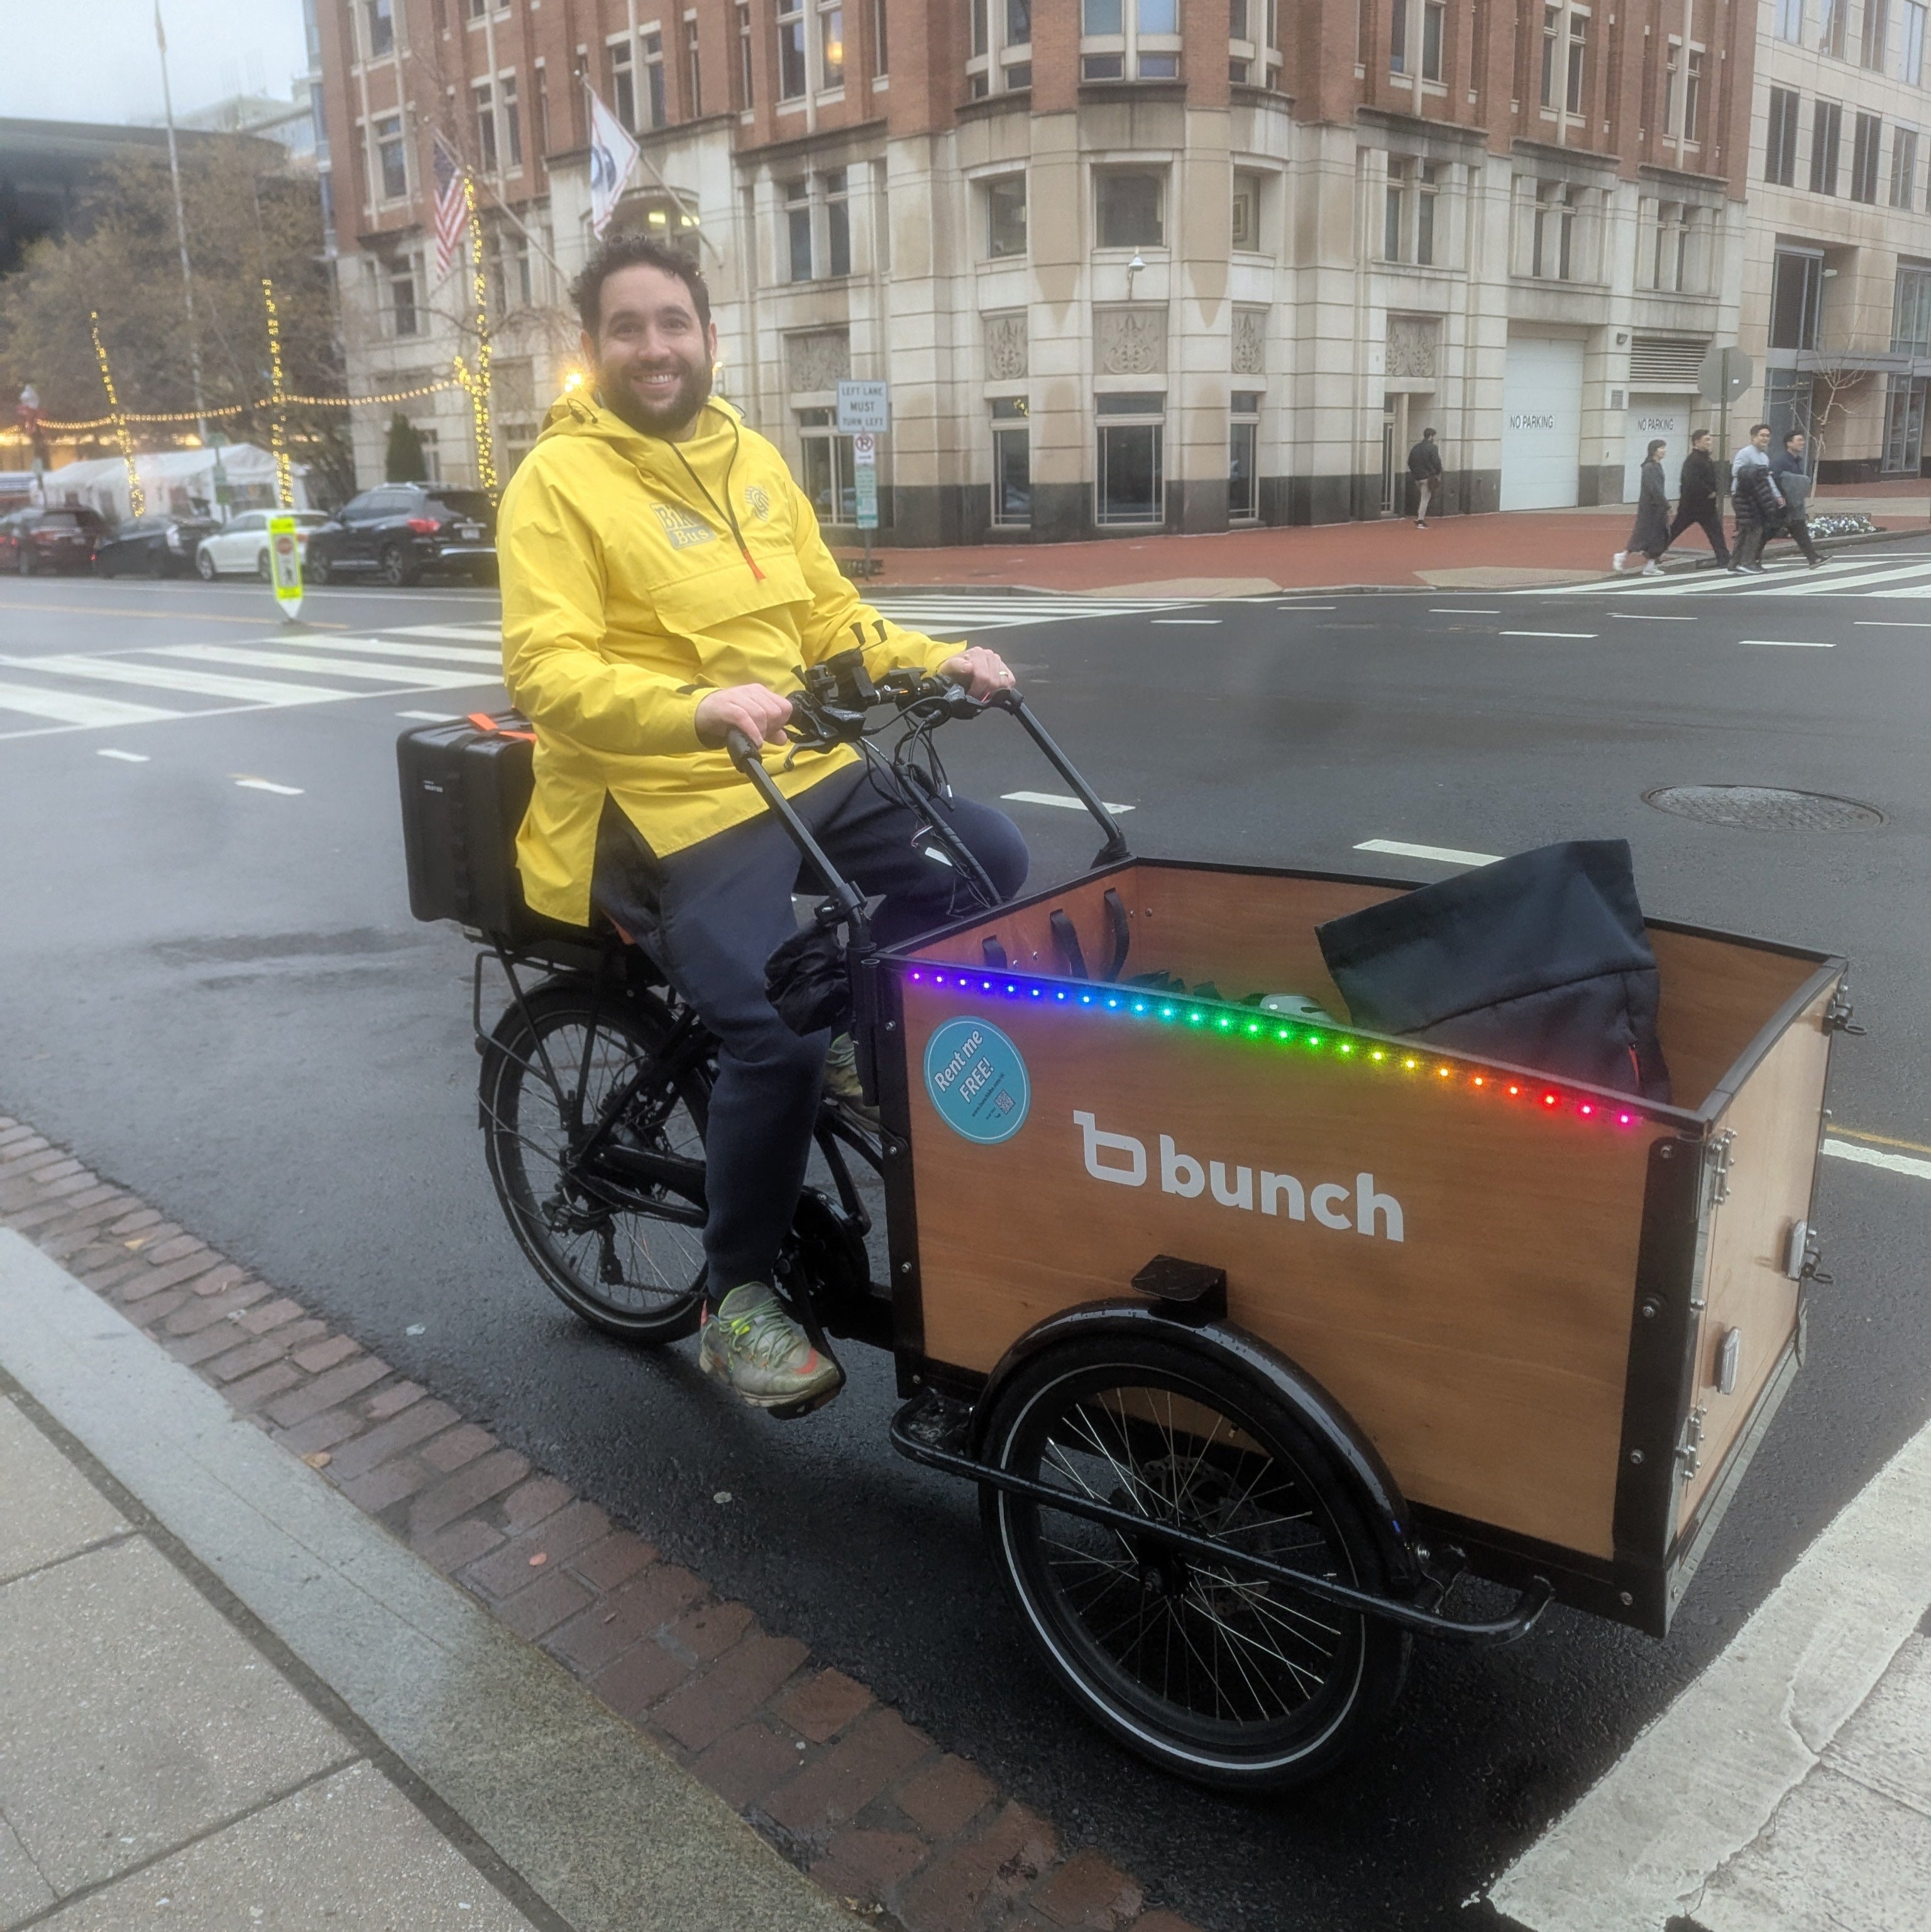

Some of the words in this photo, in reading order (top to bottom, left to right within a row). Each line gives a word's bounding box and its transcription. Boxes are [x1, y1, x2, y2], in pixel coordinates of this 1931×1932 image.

[842, 387, 859, 395] LEFT
[863, 386, 883, 395] LANE
[850, 401, 875, 412] MUST
[842, 417, 862, 426] TURN
[864, 417, 883, 426] LEFT
[1510, 415, 1521, 428] NO
[1522, 415, 1553, 428] PARKING
[1638, 418, 1647, 431] NO
[1648, 418, 1674, 430] PARKING
[674, 529, 709, 544] Bus
[934, 1051, 966, 1093] Rent
[961, 1030, 984, 1059] me
[958, 1056, 995, 1103] FREE!
[1160, 1134, 1404, 1242] bunch
